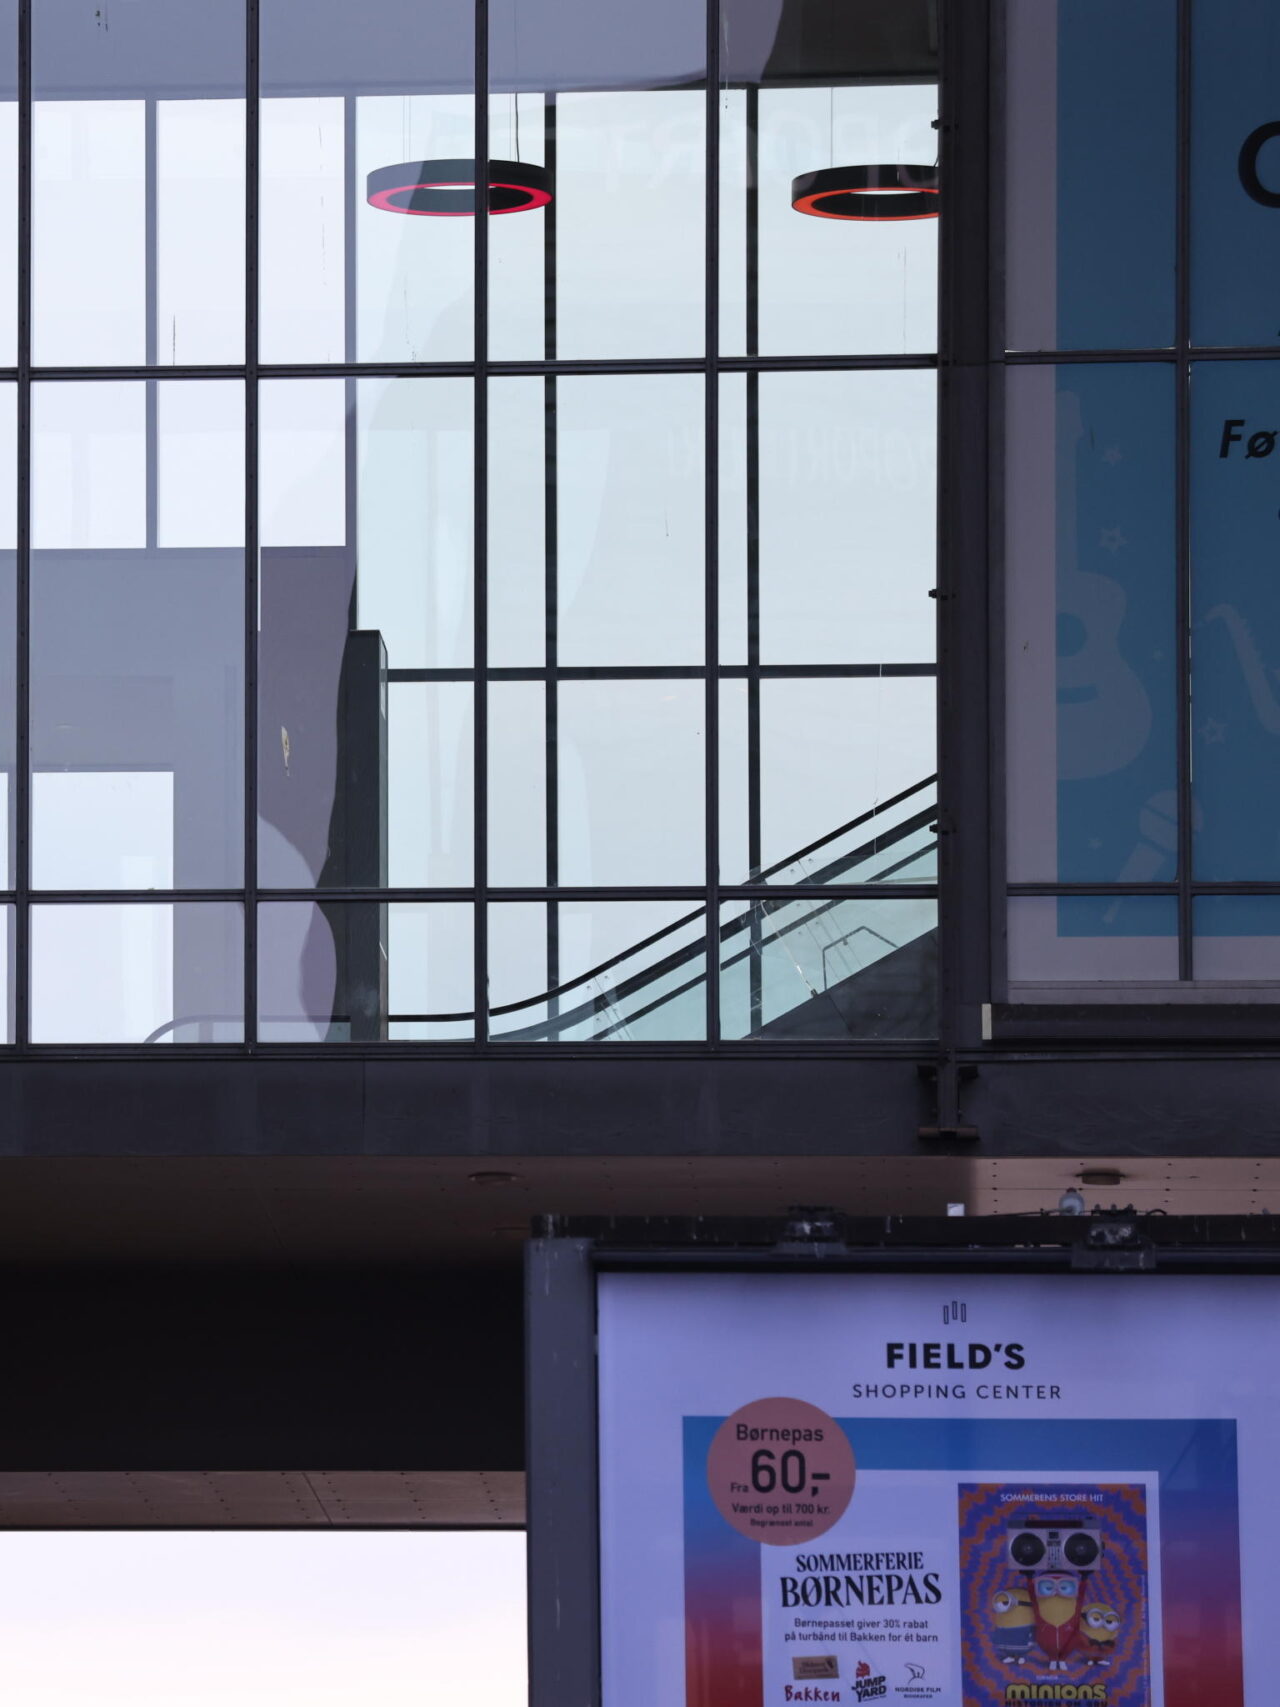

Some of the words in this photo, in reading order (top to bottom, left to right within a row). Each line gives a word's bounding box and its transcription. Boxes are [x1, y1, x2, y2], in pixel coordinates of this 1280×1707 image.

[887, 1343, 1025, 1370] FIELD'S
[853, 1384, 965, 1399] SHOPPING
[975, 1384, 1061, 1400] CENTER
[737, 1424, 823, 1445] Børnepas
[730, 1482, 749, 1493] Fra
[752, 1449, 830, 1497] 60,-
[1000, 1493, 1058, 1502] SOMMERENS
[1059, 1493, 1087, 1502] STORE
[1089, 1493, 1104, 1502] HIT
[731, 1503, 764, 1514] Værdi
[765, 1505, 780, 1516] op
[781, 1503, 793, 1514] til
[794, 1503, 815, 1515] 700
[796, 1552, 923, 1572] SOMMERFERIE
[780, 1573, 942, 1608] BØRNEPAS
[794, 1617, 855, 1630] Børnepasset
[856, 1620, 881, 1631] giver
[883, 1618, 901, 1629] 30%
[902, 1619, 929, 1629] rabat
[784, 1631, 797, 1643] på
[798, 1631, 836, 1642] turbånd
[838, 1631, 848, 1641] til
[849, 1631, 886, 1642] Bakken
[888, 1632, 902, 1642] for
[915, 1632, 939, 1643] barn
[851, 1675, 886, 1692] JUMP
[785, 1685, 840, 1702] Bakken
[856, 1684, 887, 1703] YARD
